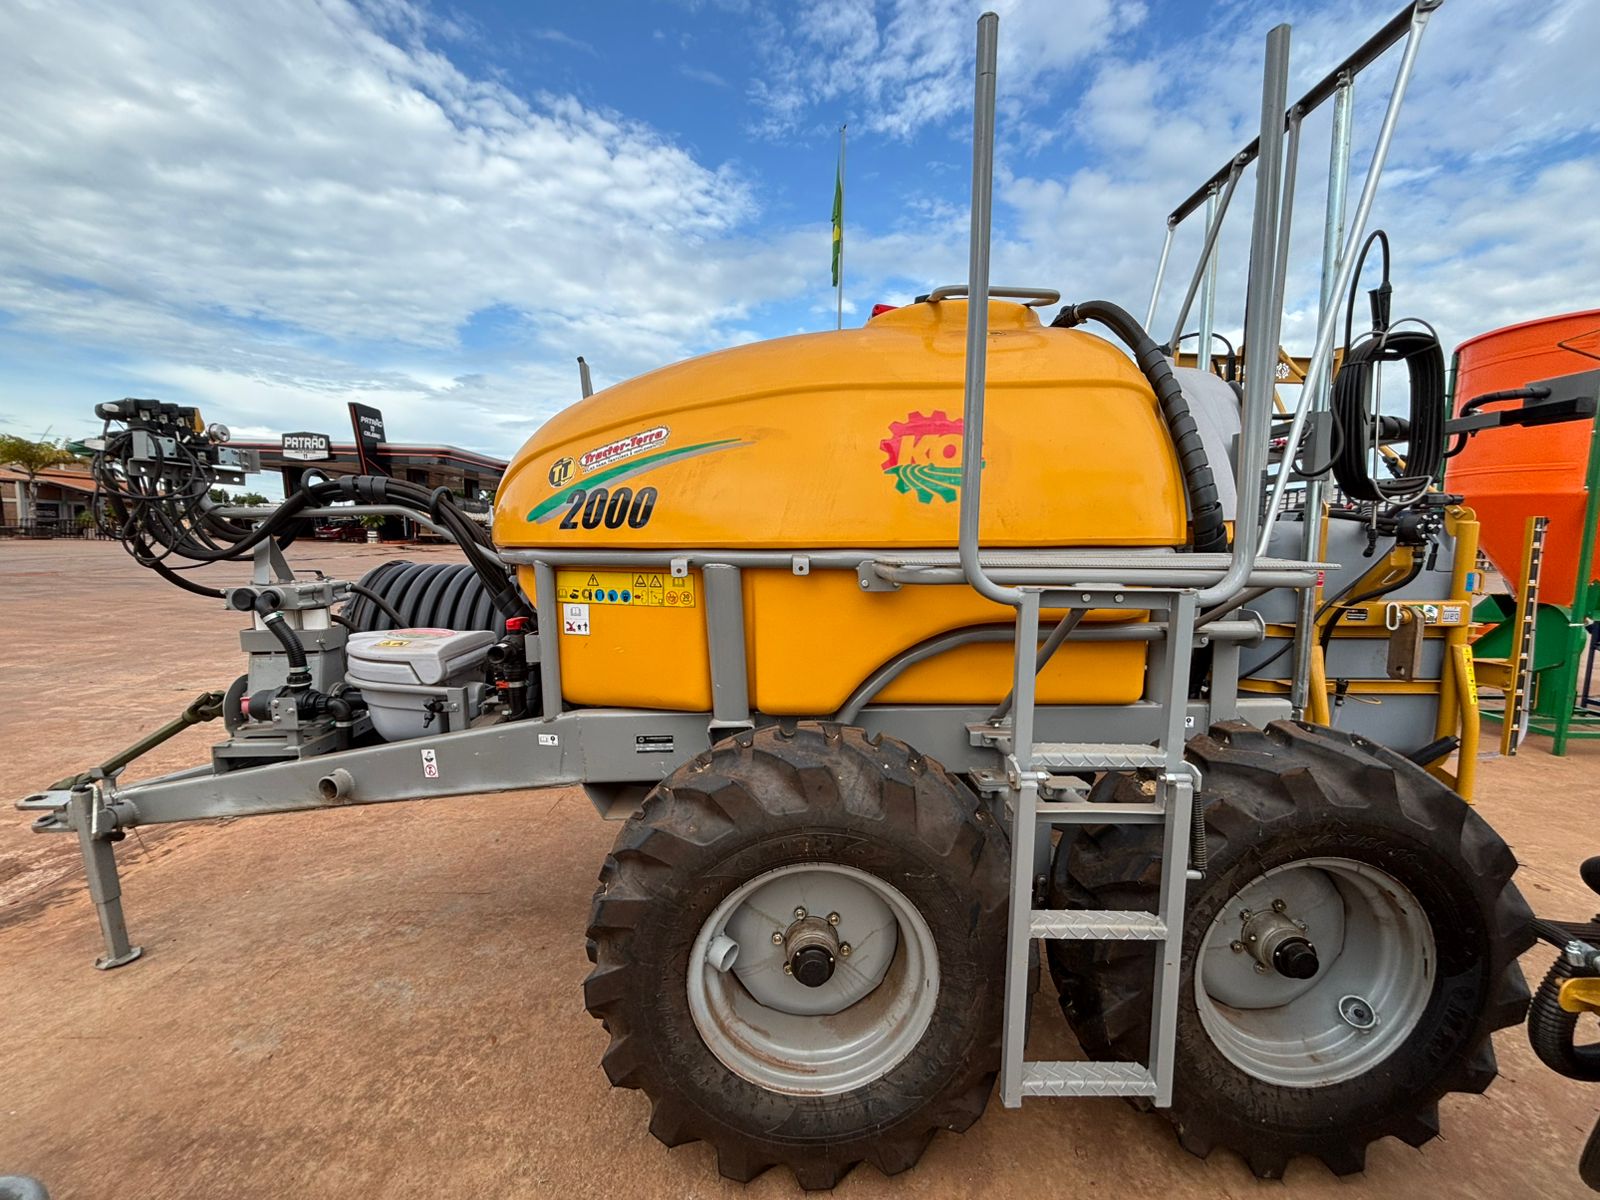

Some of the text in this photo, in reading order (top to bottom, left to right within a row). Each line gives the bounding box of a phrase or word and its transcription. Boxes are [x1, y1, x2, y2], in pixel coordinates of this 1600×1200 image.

[284, 435, 326, 448] PATRÃO
[585, 430, 664, 464] Tractor-Terra
[559, 487, 658, 530] 2000
